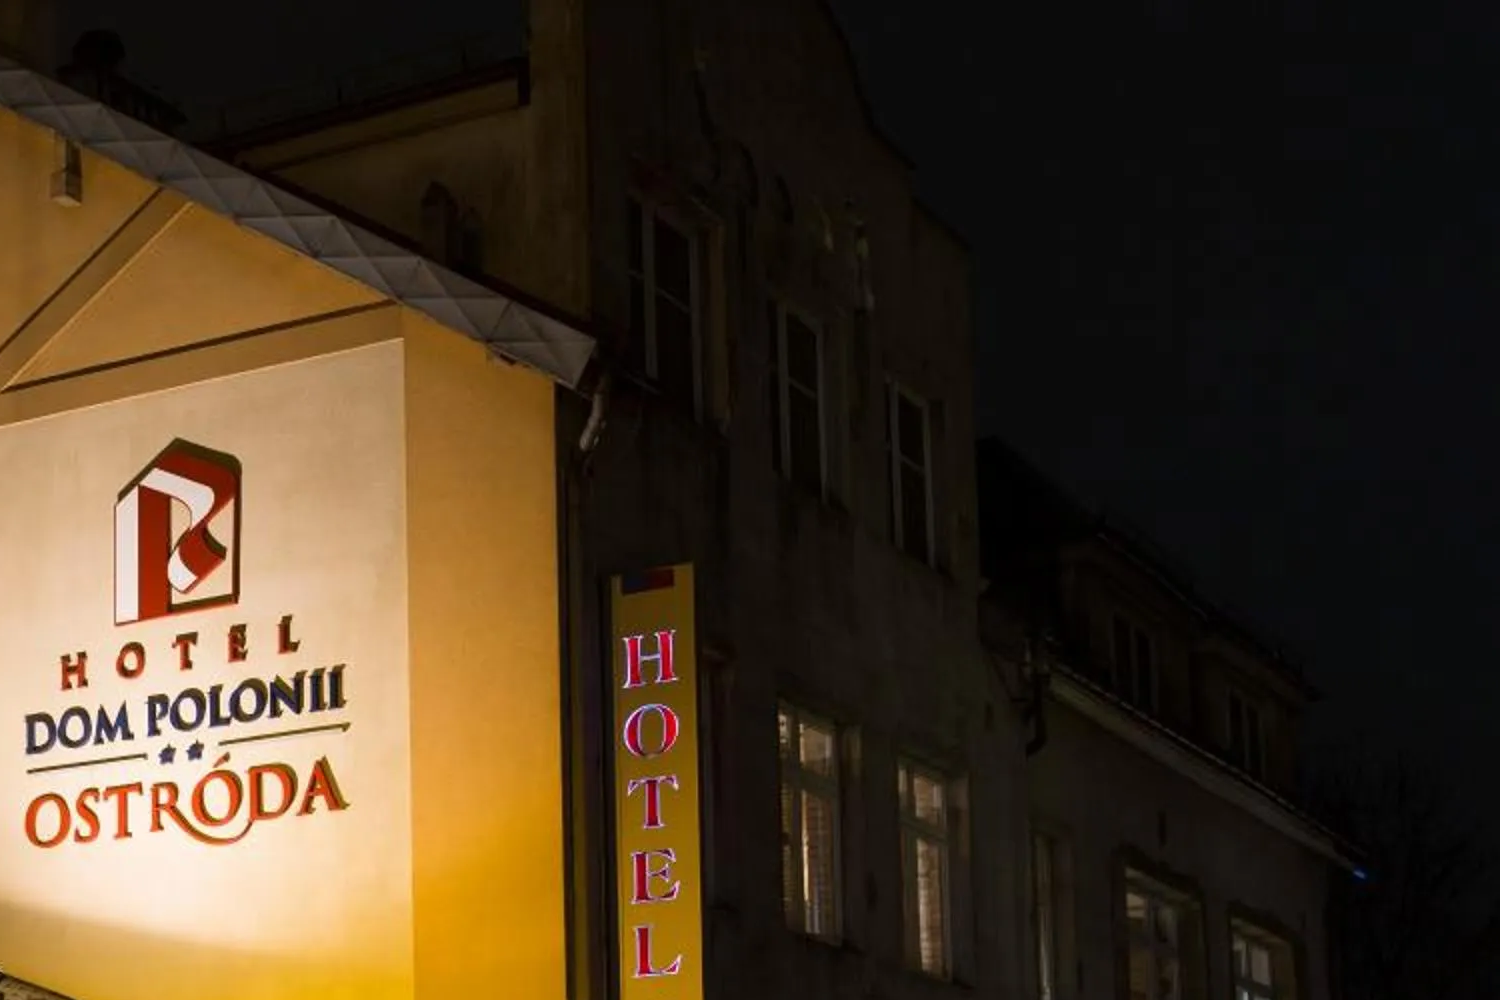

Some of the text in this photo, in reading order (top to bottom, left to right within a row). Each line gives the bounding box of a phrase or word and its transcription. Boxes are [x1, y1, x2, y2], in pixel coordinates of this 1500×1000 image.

[61, 615, 300, 691] HOTEL
[25, 663, 348, 756] DOM POLONII
[25, 752, 351, 848] OSTRÓDA
[622, 629, 684, 979] HOTEL
